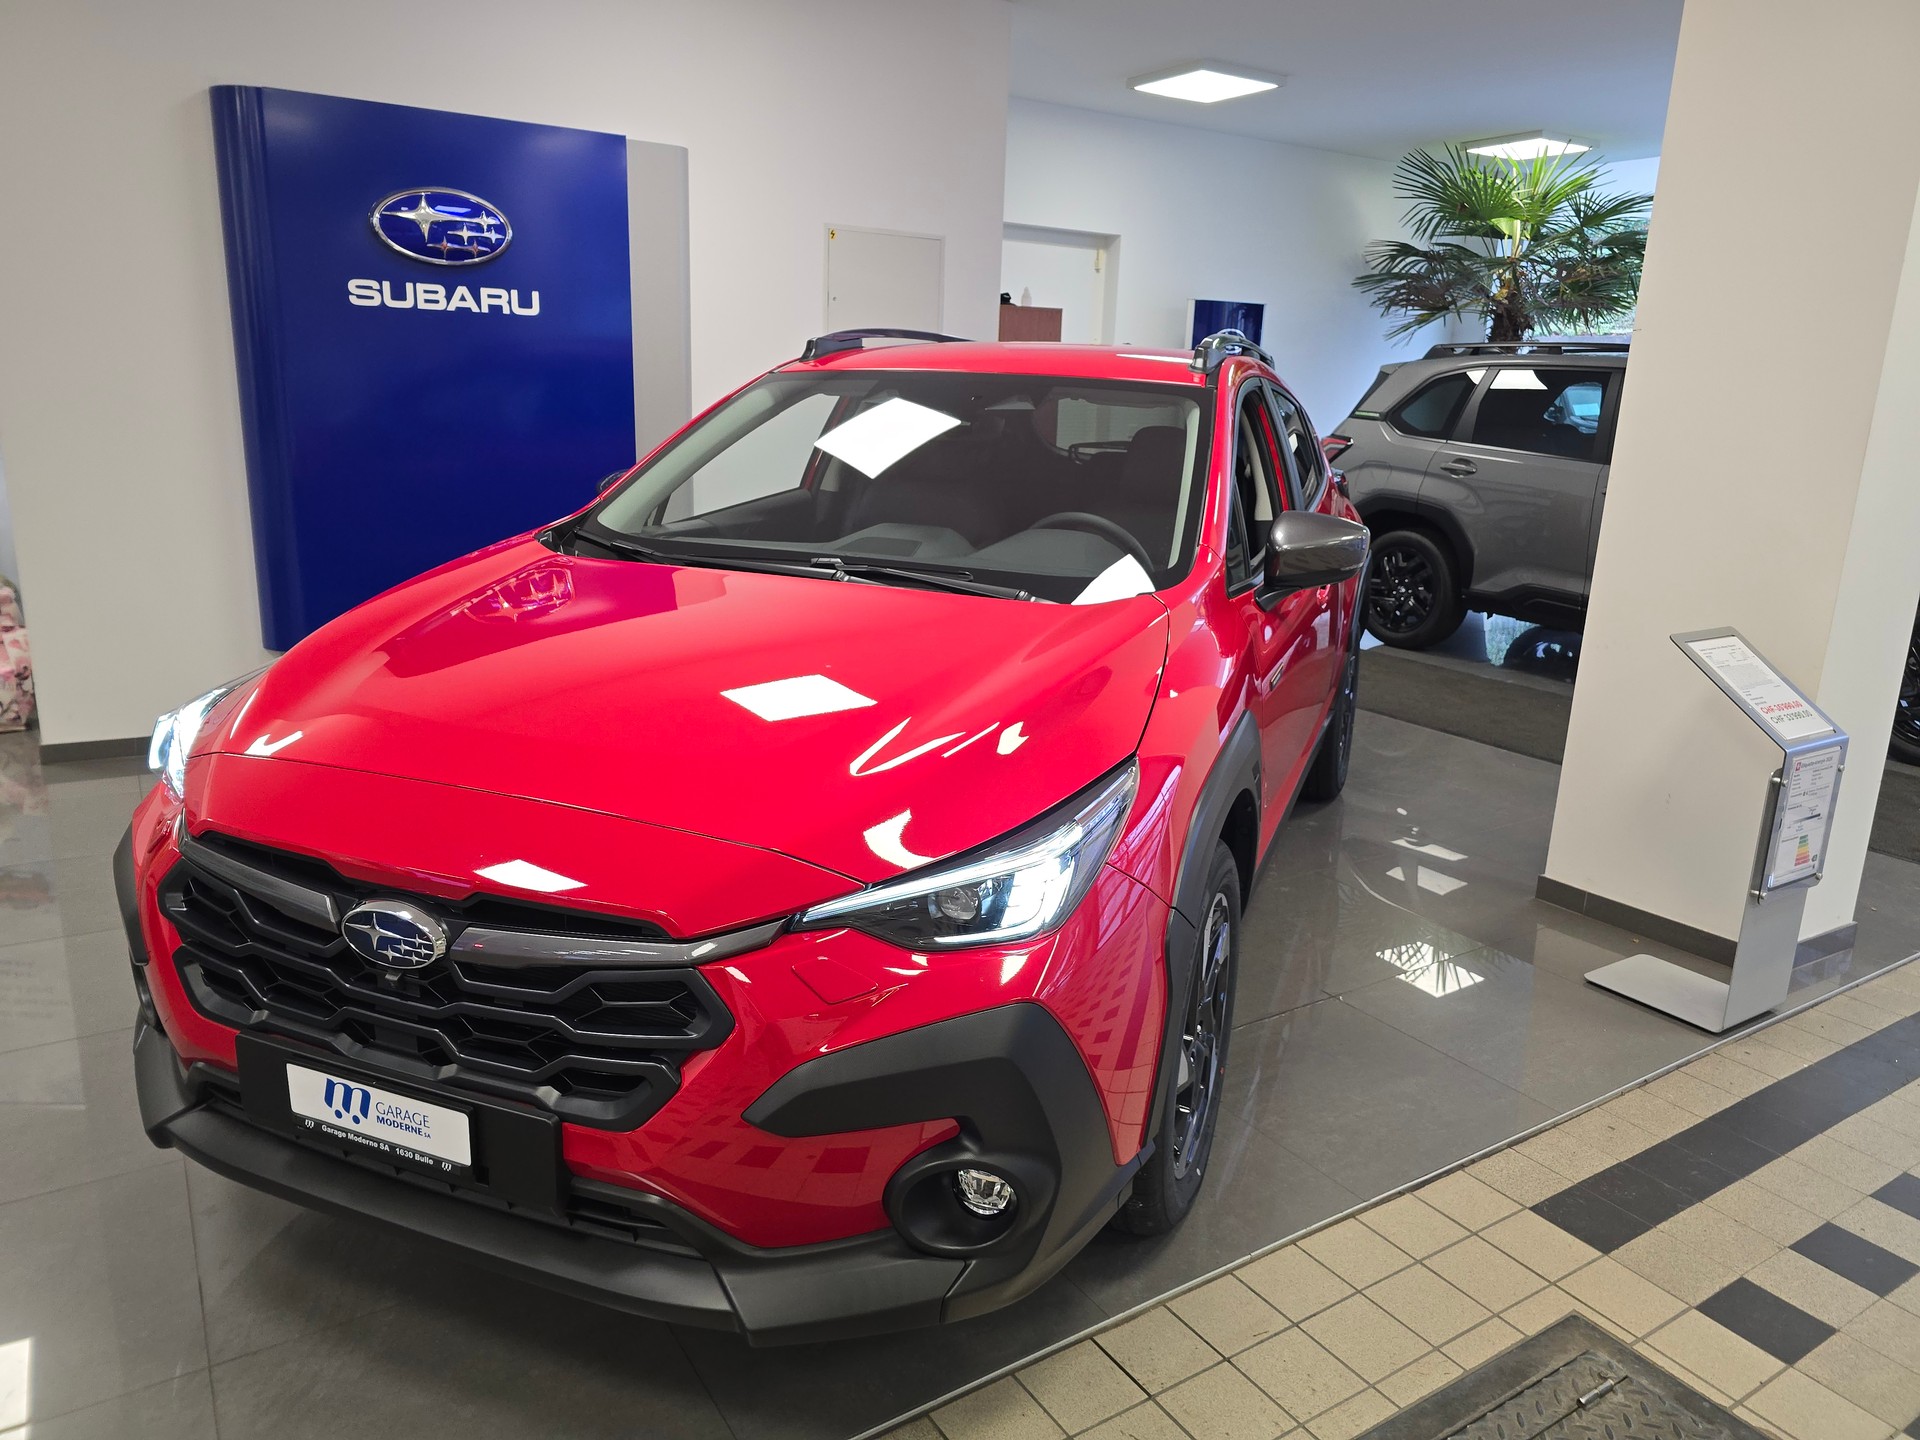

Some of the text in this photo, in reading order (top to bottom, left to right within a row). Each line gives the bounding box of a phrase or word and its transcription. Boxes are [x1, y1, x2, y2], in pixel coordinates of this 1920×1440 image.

[347, 278, 540, 316] SUBARU
[1760, 705, 1775, 715] CHF
[1770, 715, 1785, 724] CHF
[375, 1101, 431, 1129] GARAGE
[376, 1115, 423, 1136] MODERNE
[321, 1124, 347, 1138] Garage
[347, 1132, 379, 1148] Moderne
[379, 1142, 390, 1152] SA
[395, 1147, 414, 1159] 1630
[414, 1153, 434, 1165] Bulle
